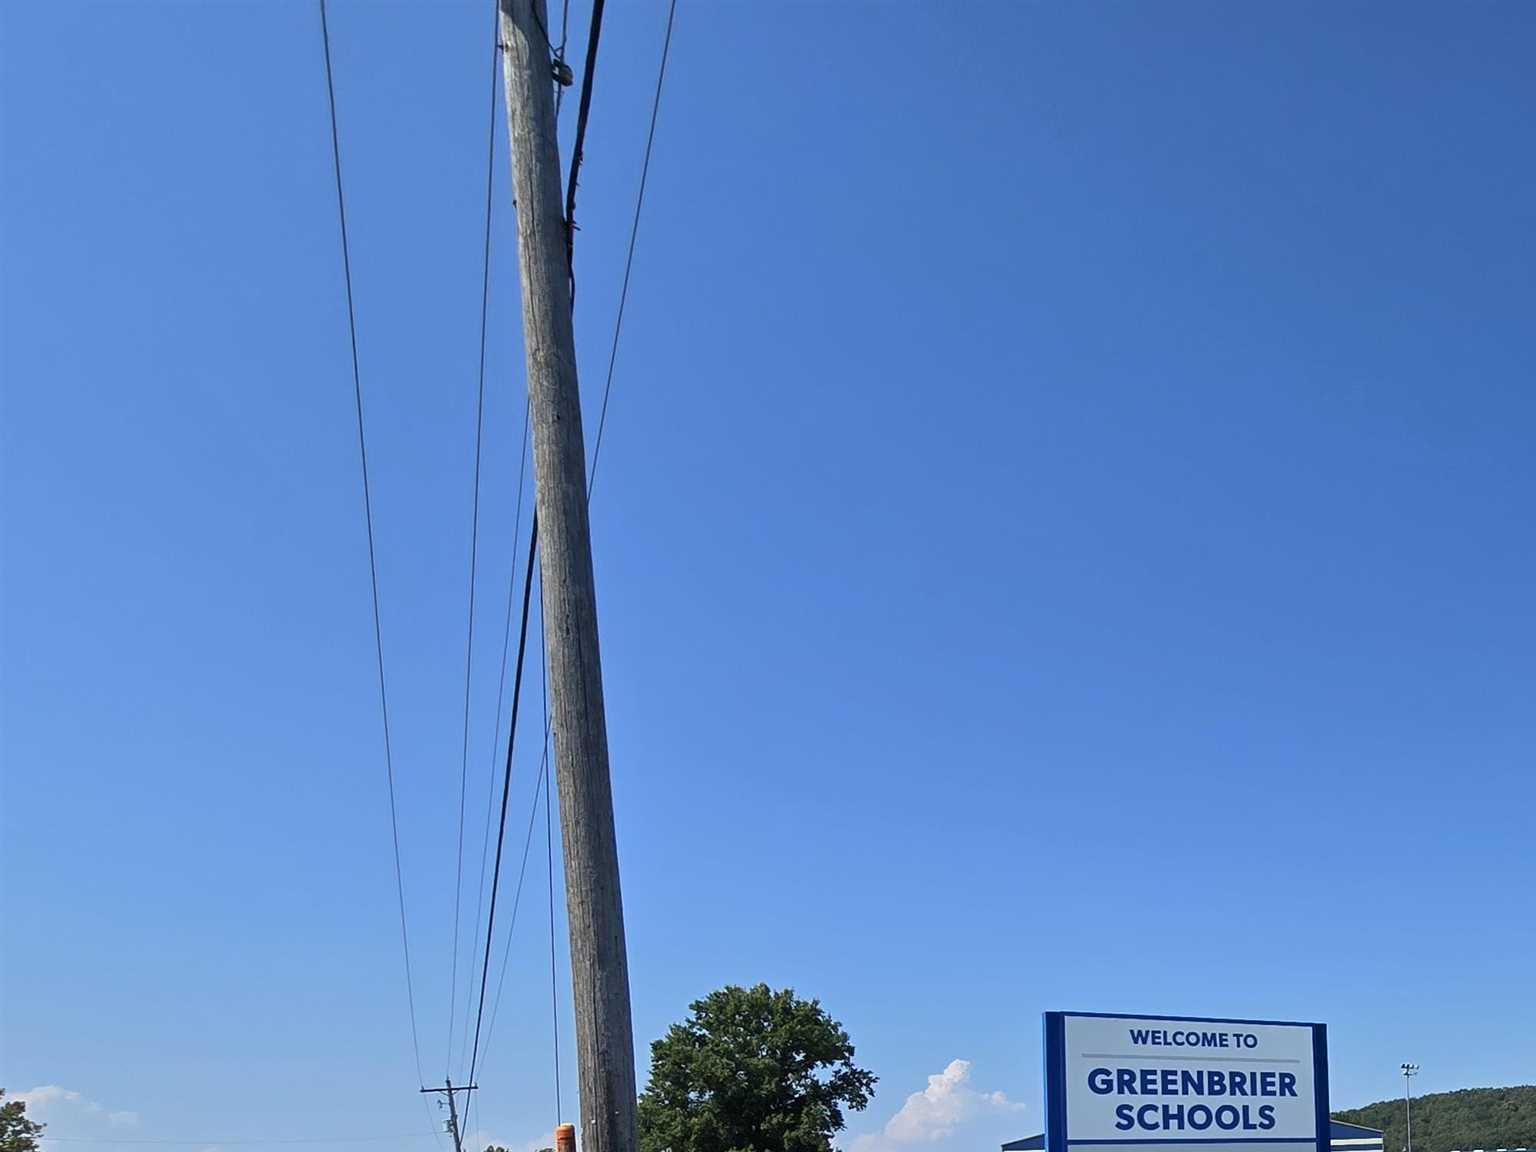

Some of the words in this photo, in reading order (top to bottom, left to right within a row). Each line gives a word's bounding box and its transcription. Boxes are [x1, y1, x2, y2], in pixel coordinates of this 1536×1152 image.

[1130, 1029, 1229, 1047] WELCOME
[1233, 1033, 1258, 1048] TO
[1087, 1068, 1298, 1097] GREENBRIER
[1115, 1104, 1276, 1131] SCHOOLS
